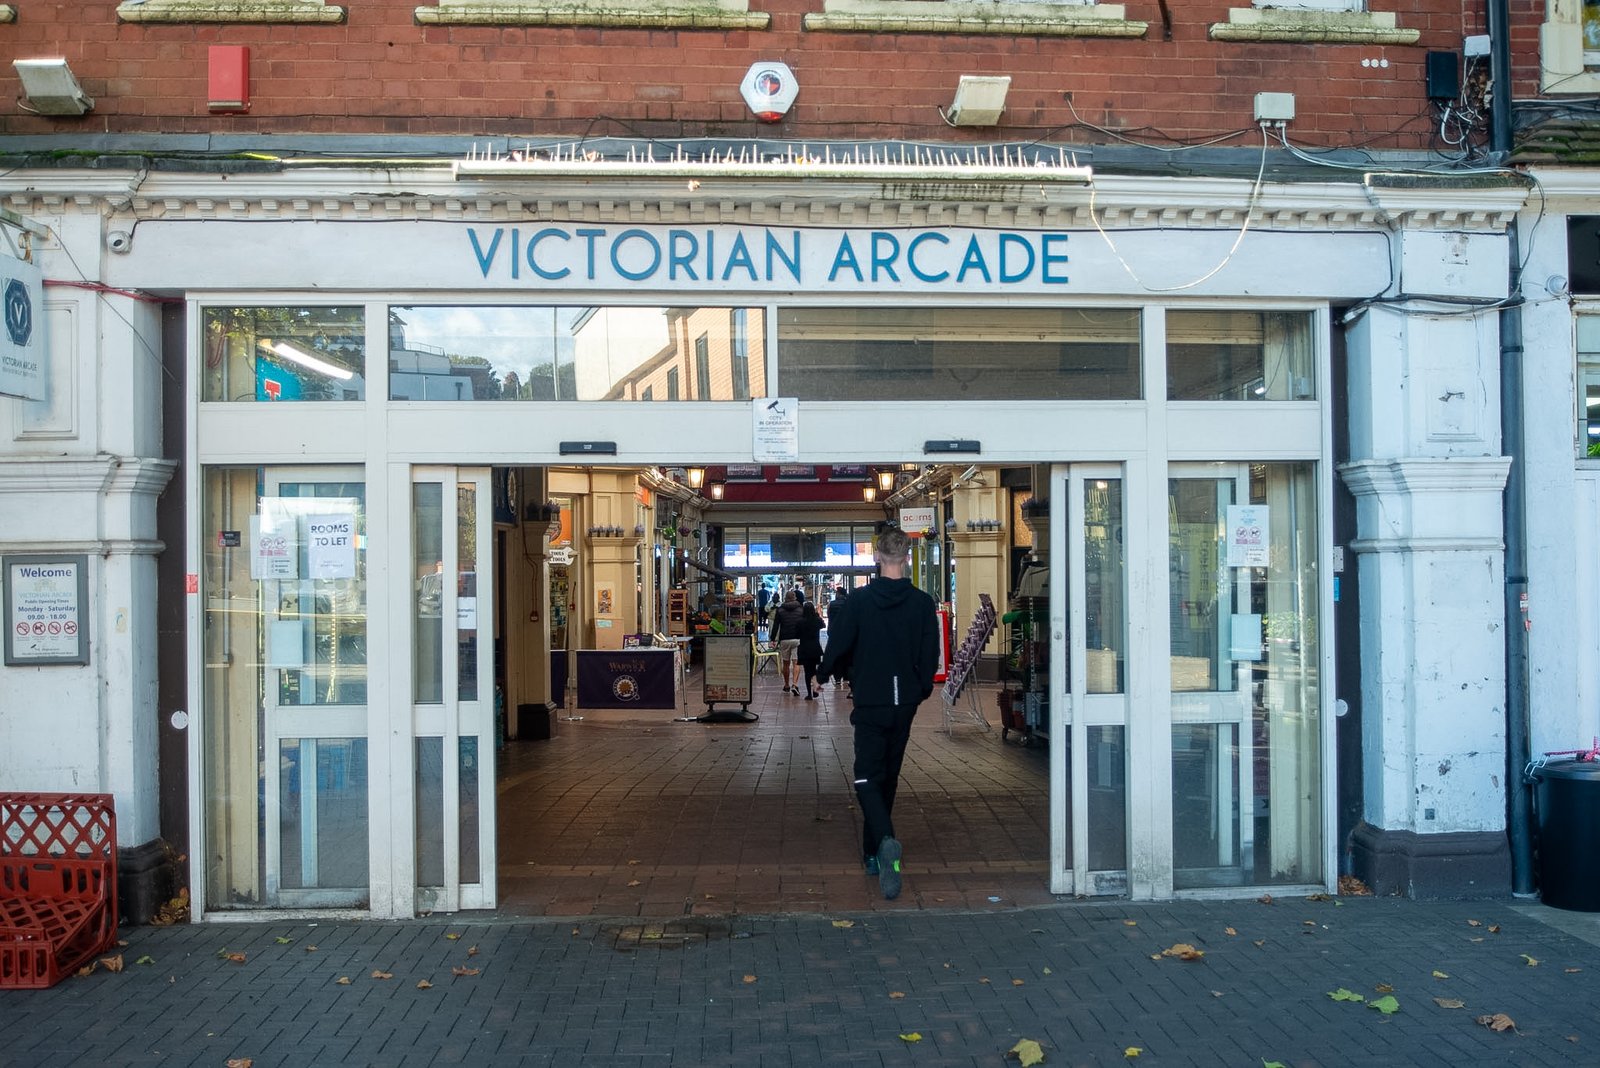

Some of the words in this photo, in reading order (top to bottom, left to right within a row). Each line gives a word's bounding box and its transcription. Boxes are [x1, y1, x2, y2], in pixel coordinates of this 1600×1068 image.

[467, 227, 801, 284] VICTORIAN
[827, 231, 1069, 284] ARCADE
[14, 302, 23, 325] V
[310, 524, 349, 533] ROOMS
[315, 537, 329, 546] TO
[331, 537, 347, 546] LET
[20, 567, 72, 578] Welcome
[729, 687, 748, 697] £35
